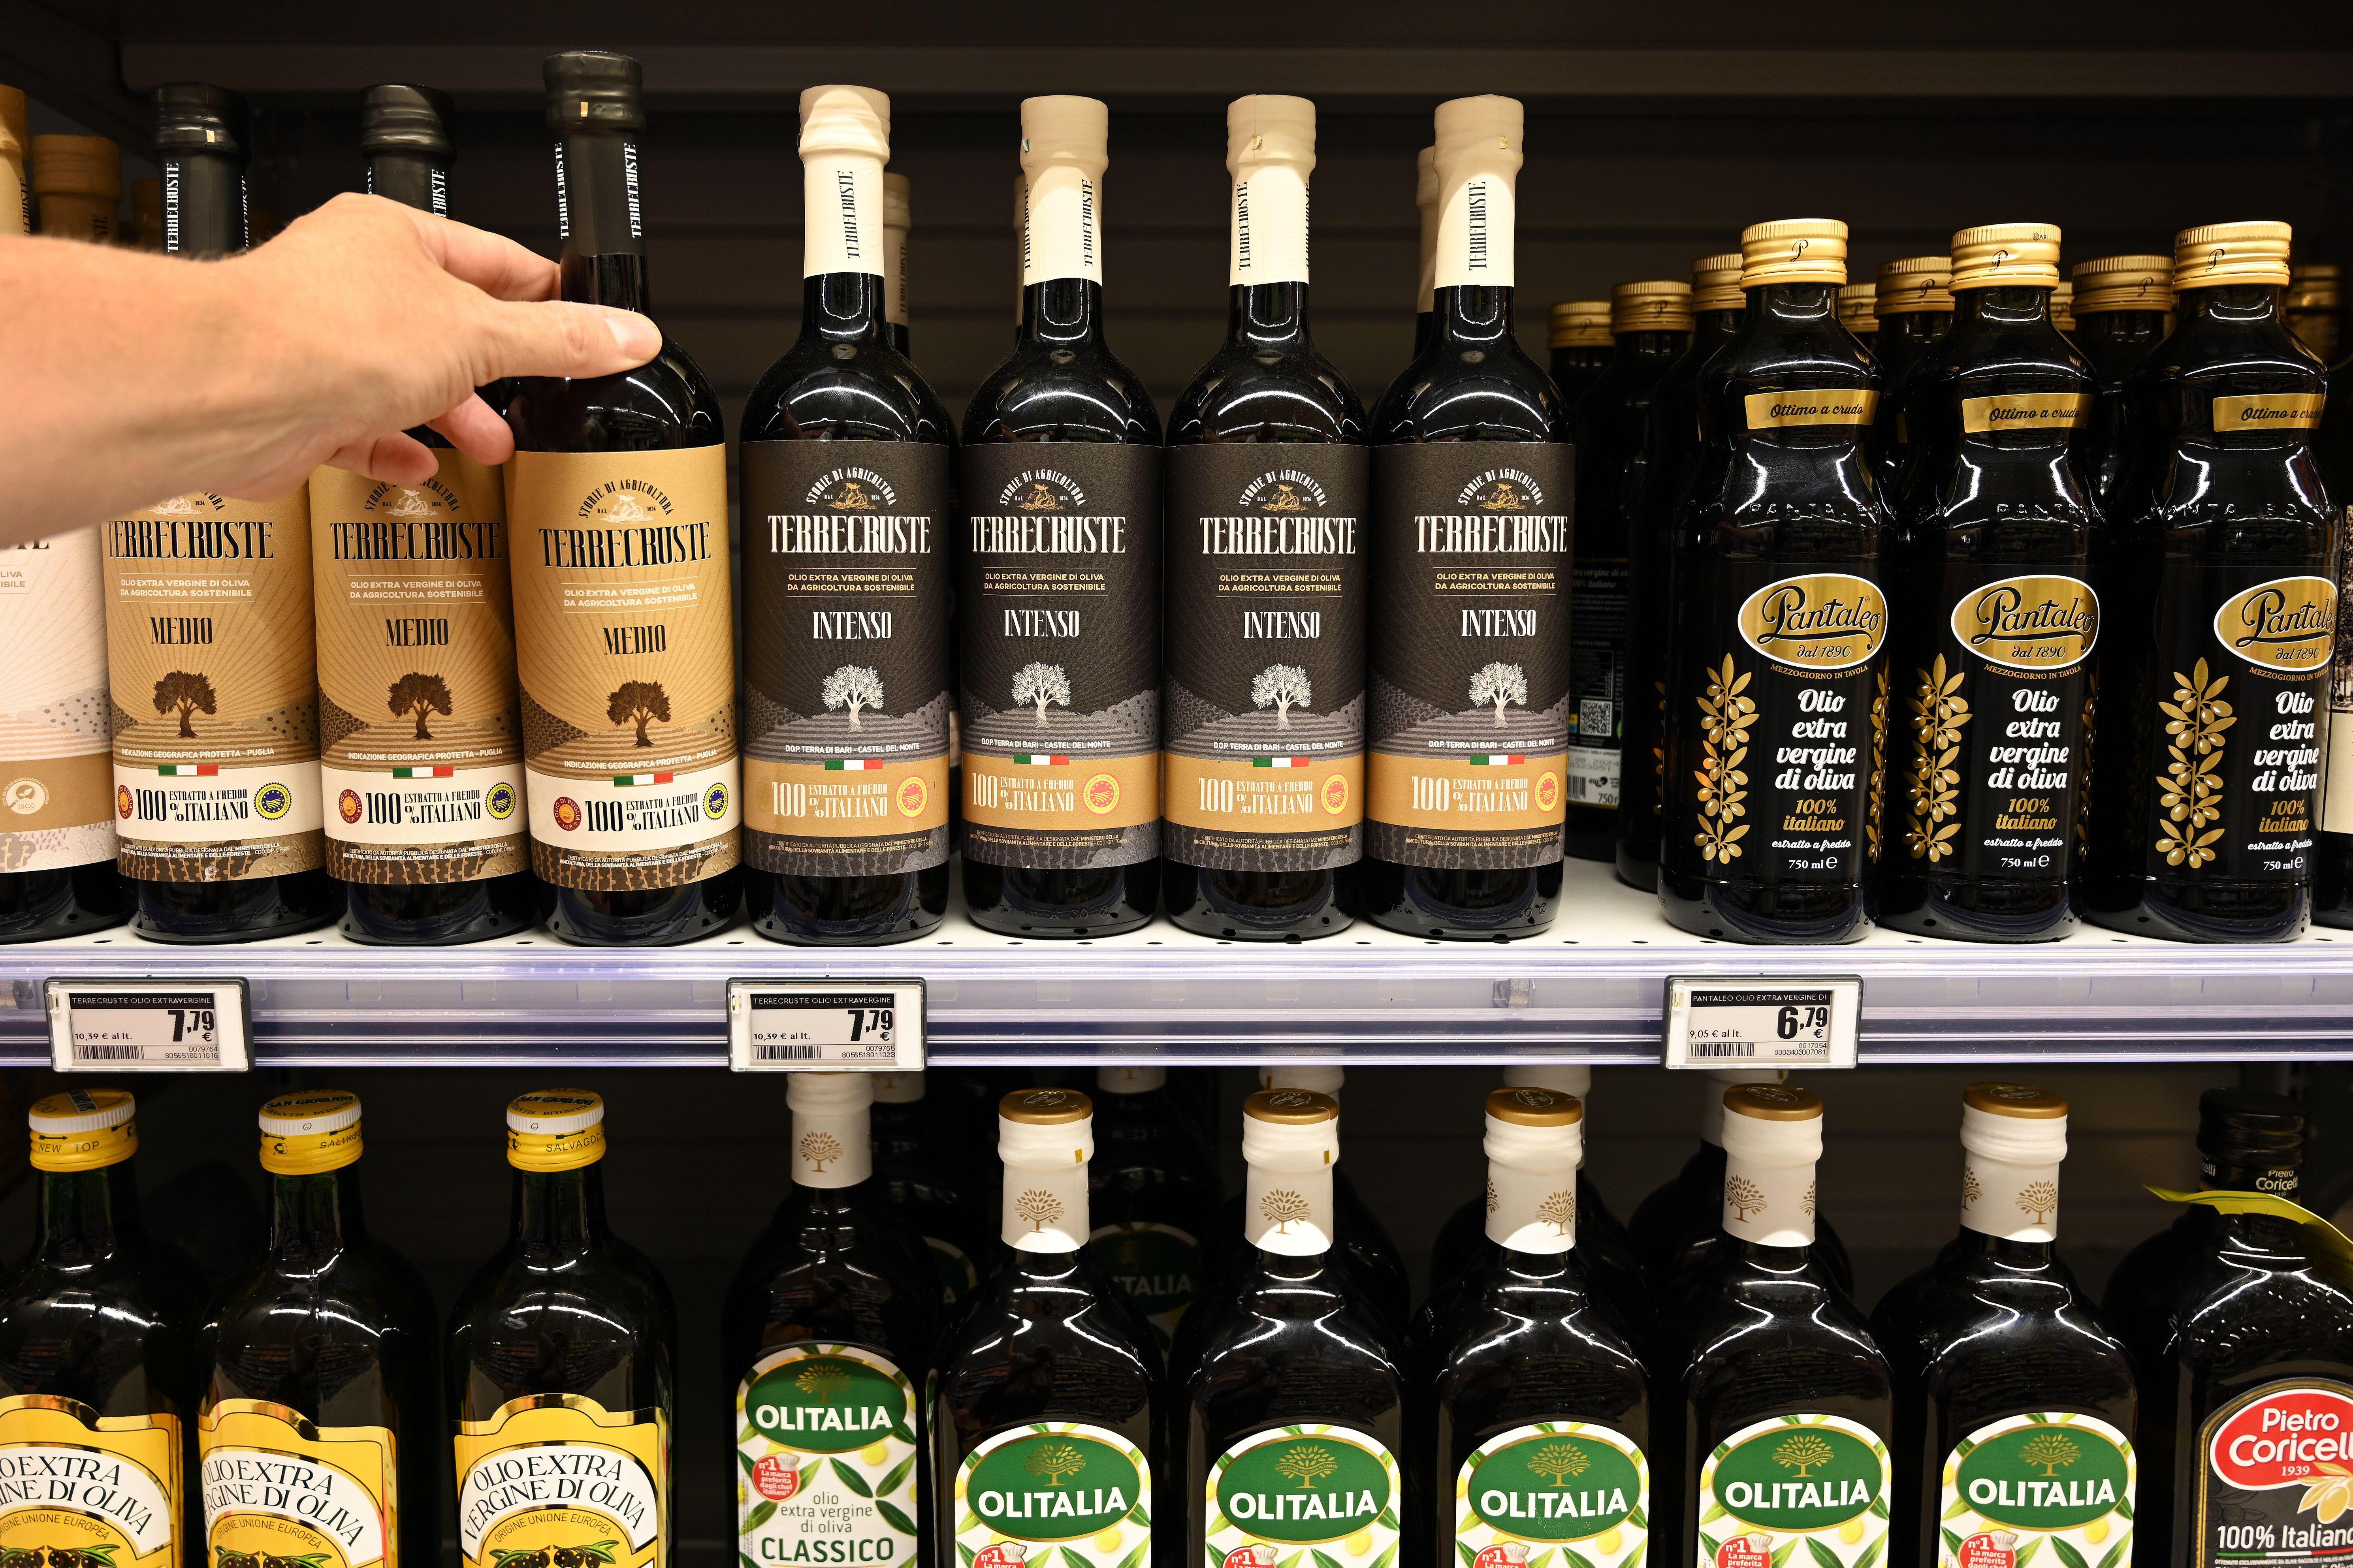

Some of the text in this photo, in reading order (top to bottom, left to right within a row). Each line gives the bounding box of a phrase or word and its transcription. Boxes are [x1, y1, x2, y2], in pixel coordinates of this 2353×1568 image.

[555, 143, 569, 239] TERRECRUSTE
[624, 143, 641, 238] TERRECRUSTE
[166, 163, 179, 252] TERRECRUSTE
[838, 171, 860, 259] TERRECRUSTE
[1082, 179, 1093, 266] TERRECRUSTE
[1237, 181, 1251, 270] TERRECRUSTE
[1469, 181, 1487, 271] TERRECRUSTE
[1770, 404, 1818, 418] Ottimo
[1832, 403, 1864, 415] crudo
[806, 467, 898, 506] STORIE DI AGRICOLTURA
[107, 521, 275, 559] TERRECRUSTE
[330, 523, 502, 561] TERRECRUSTE
[539, 522, 712, 568] TERRECRUSTE
[768, 515, 930, 553] TERRECRUSTE
[971, 517, 1126, 553] TERRECRUSTE
[1199, 517, 1356, 554] TERRECRUSTE
[1414, 516, 1568, 553] TERRECRUSTE
[578, 598, 642, 607] AGRICOLTURA
[644, 593, 697, 604] SOSTENIBILE
[620, 587, 660, 596] VERGINE
[672, 583, 695, 592] OLIVA
[150, 617, 213, 645] MEDIO
[813, 611, 892, 639] INTENSO
[1004, 610, 1079, 637] INTENSO
[1244, 611, 1320, 639] INTENSO
[1461, 609, 1536, 637] INTENSO
[1757, 585, 1881, 650] Pantaleo
[1971, 587, 2094, 651] Pantaleo
[385, 618, 449, 647] MEDIO
[603, 624, 666, 655] MEDIO
[1797, 645, 1851, 658] dal 1890
[1770, 664, 1832, 679] MEZZOGIORNO
[1844, 664, 1868, 678] TAVOLA
[1798, 689, 1846, 713] Olio
[2012, 689, 2059, 713] Olio
[2275, 691, 2314, 714] Olio
[1792, 718, 1847, 738] extra
[2006, 718, 2061, 738] extra
[2270, 720, 2315, 740] extra
[348, 752, 387, 761] INDICAZIONE
[388, 752, 435, 761] GEOGRAFICA
[436, 750, 474, 760] PROTETTA
[1776, 743, 1856, 771] vergine
[1989, 742, 2069, 771] vergine
[2254, 744, 2319, 772] vergine
[972, 773, 998, 808] 100
[1237, 780, 1313, 792] ESTRATTO A FREDDO
[1412, 776, 1449, 811] 100
[1775, 768, 1855, 790] di oliva
[136, 788, 167, 822] 100
[366, 792, 401, 824] 100
[772, 781, 806, 817] 100
[1199, 777, 1233, 813] 100
[1796, 799, 1837, 814] 100%
[2009, 798, 2049, 813] 100%
[2270, 800, 2304, 815] 100%
[585, 800, 624, 832] 100
[1783, 816, 1845, 831] italiano
[1995, 814, 2057, 830] italiano
[1772, 840, 1812, 849] estratto
[1820, 840, 1851, 852] freddo
[1789, 859, 1824, 869] 750 ml
[168, 1010, 215, 1042] 7,79
[848, 1010, 893, 1041] 7,79
[880, 1032, 890, 1041] €
[1690, 1030, 1709, 1039] 9,05
[1777, 1006, 1828, 1039] 6,79
[1813, 1030, 1822, 1038] €
[202, 1033, 212, 1042] €
[39, 1141, 100, 1153] NEW TOP
[755, 1404, 893, 1431] OLITALIA
[2262, 1408, 2339, 1432] Pietro
[21, 1456, 120, 1485] EXTRA
[474, 1455, 621, 1491] OLIO EXTRA
[2281, 1466, 2310, 1476] 1939
[978, 1487, 1128, 1517] OLITALIA
[1229, 1489, 1378, 1520] OLITALIA
[1481, 1487, 1628, 1518] OLITALIA
[1725, 1479, 1870, 1508] OLITALIA
[1969, 1478, 2116, 1507] OLITALIA
[465, 1479, 646, 1540] VERGINE DI OLIVA
[495, 1513, 612, 1542] ORIGINE UNIONE EUROPEA
[2217, 1525, 2275, 1549] 100%
[761, 1537, 894, 1562] CLASSICO
